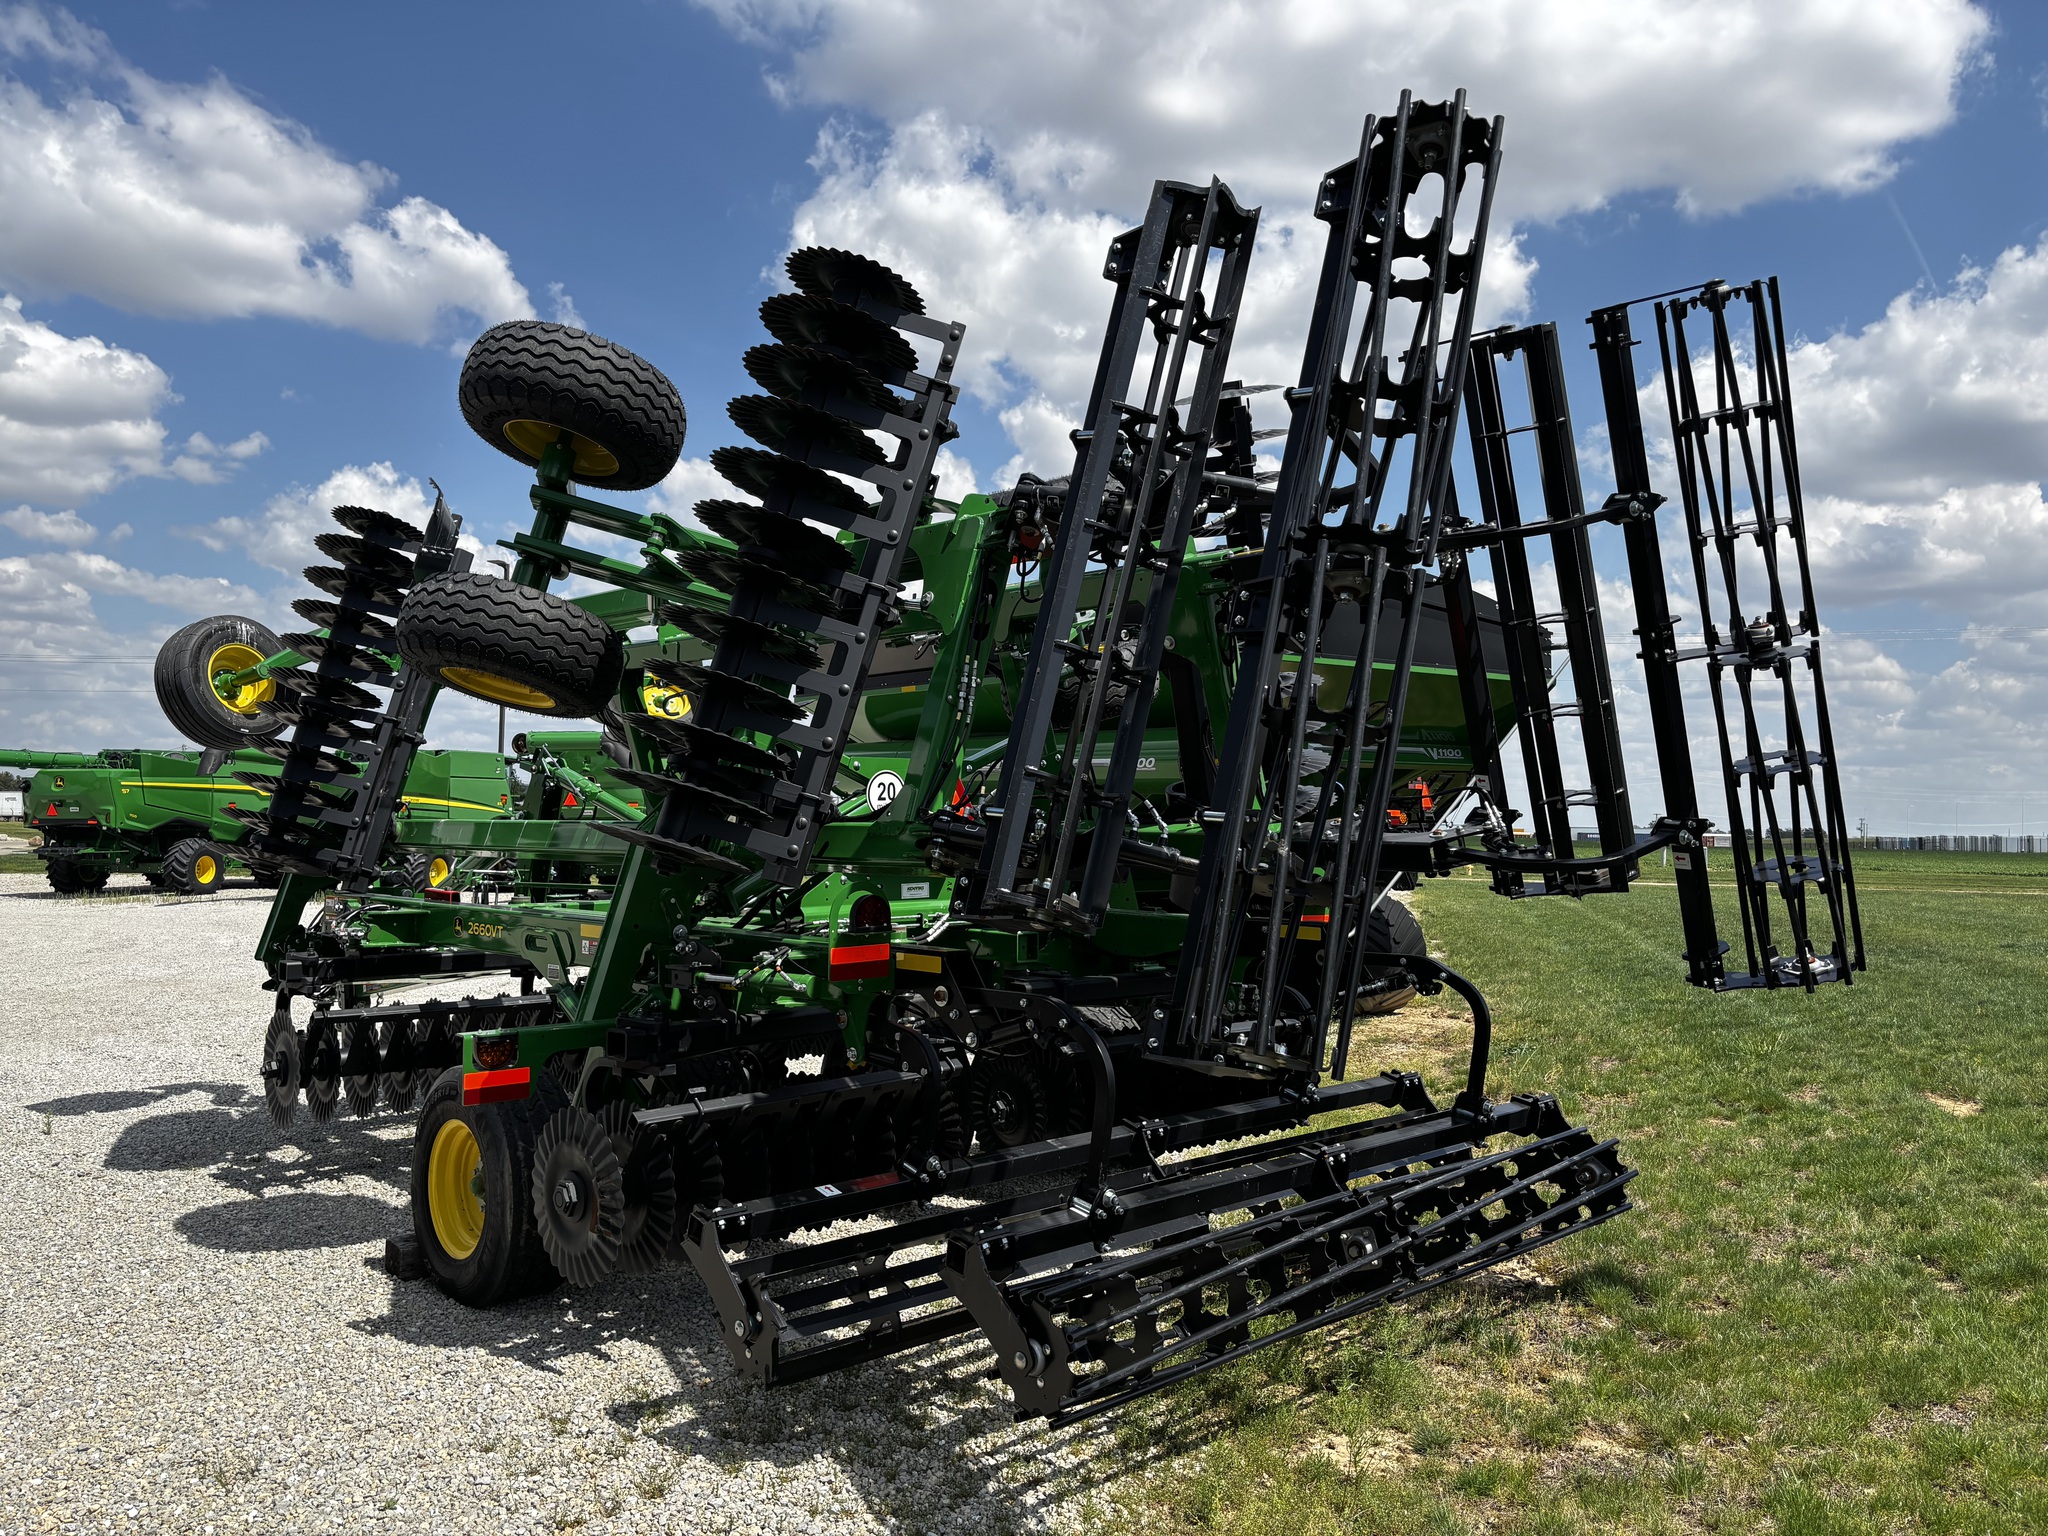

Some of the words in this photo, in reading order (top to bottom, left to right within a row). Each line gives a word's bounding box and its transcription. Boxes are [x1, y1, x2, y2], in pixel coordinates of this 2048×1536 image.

[1427, 747, 1463, 760] V1100
[877, 782, 896, 801] 20
[467, 921, 503, 938] 2660VT
